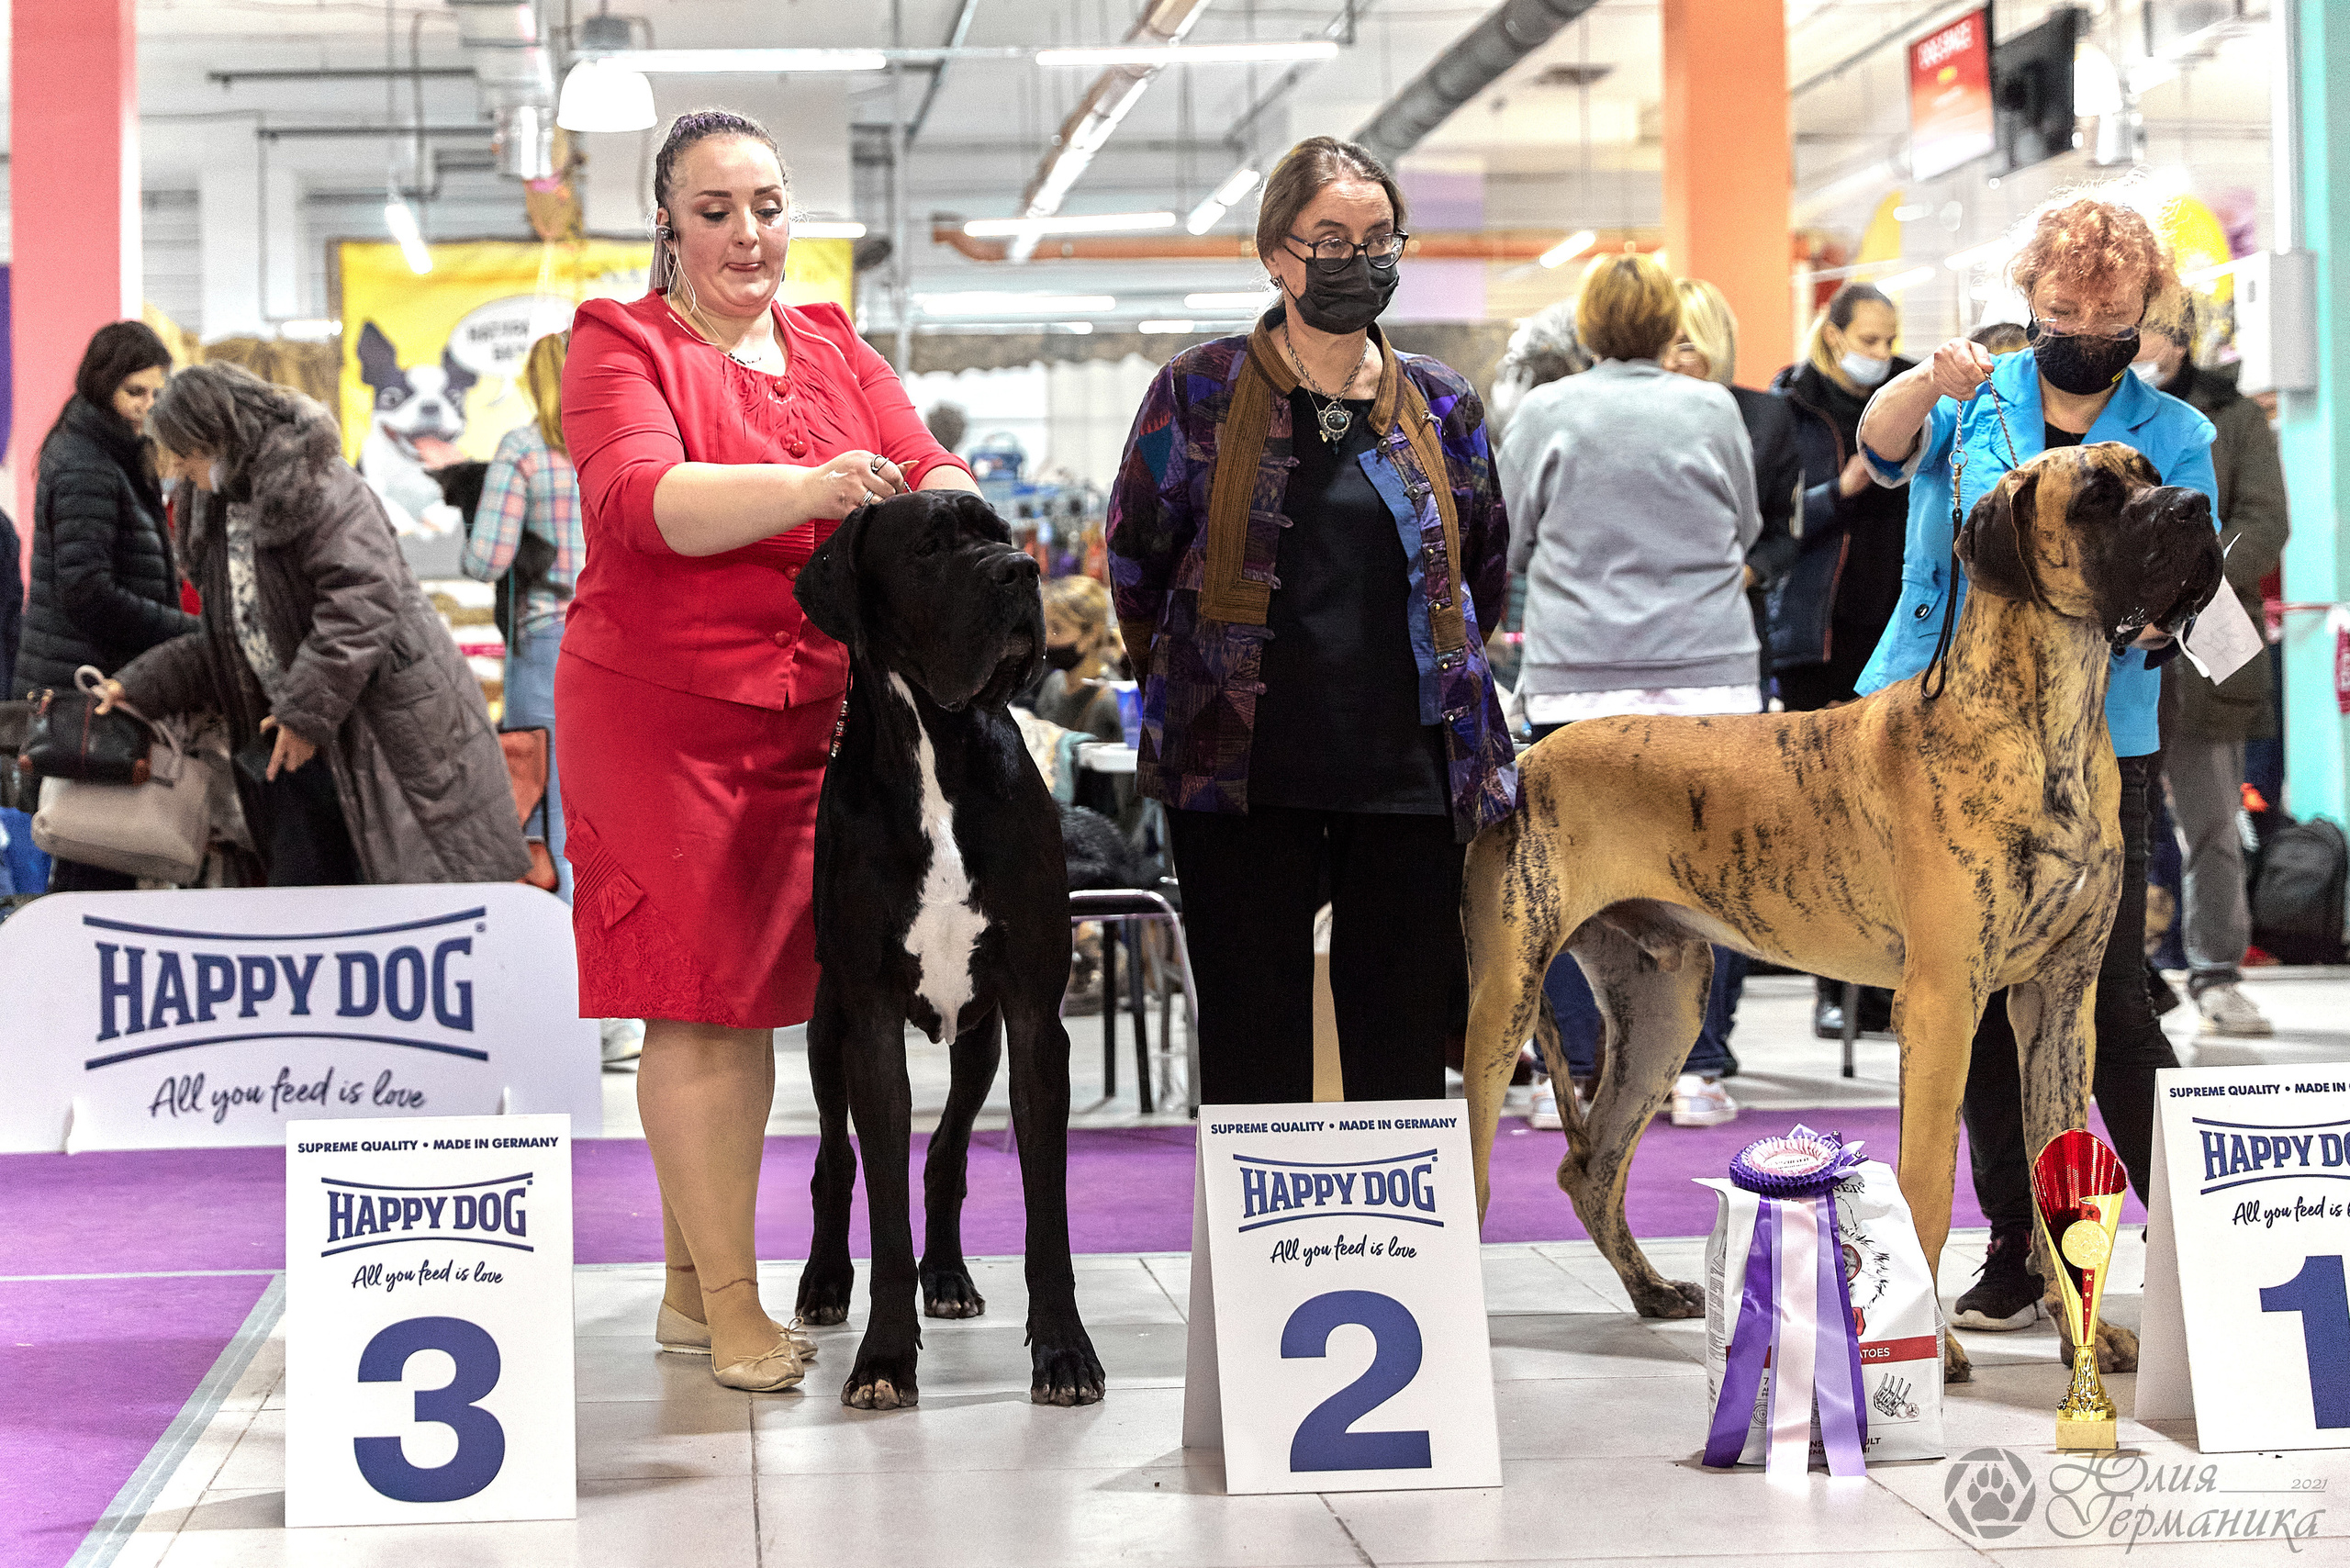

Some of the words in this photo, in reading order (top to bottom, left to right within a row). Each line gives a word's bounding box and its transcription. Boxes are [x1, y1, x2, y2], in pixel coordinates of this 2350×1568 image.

[95, 941, 323, 1041] HAPPY
[150, 1073, 205, 1116] All
[212, 1086, 263, 1124] you
[272, 1067, 333, 1112] feed
[340, 1082, 363, 1104] is
[373, 1070, 425, 1108] love
[2170, 1086, 2225, 1097] SUPREME
[2228, 1084, 2280, 1095] QUALITY
[2295, 1083, 2330, 1092] MADE
[2333, 1082, 2345, 1092] IN
[298, 1142, 357, 1153] SUPREME
[362, 1140, 418, 1151] QUALITY
[433, 1139, 470, 1149] MADE
[475, 1139, 488, 1148] IN
[493, 1137, 558, 1148] GERMANY
[1211, 1123, 1268, 1134] SUPREME
[1271, 1122, 1324, 1132] QUALITY
[1339, 1120, 1374, 1130] MADE
[1378, 1120, 1391, 1129] IN
[1395, 1118, 1457, 1129] GERMANY
[2199, 1130, 2313, 1181] HAPPY
[2319, 1131, 2350, 1168] D
[328, 1191, 448, 1243] HAPPY
[1240, 1167, 1357, 1218] HAPPY
[2232, 1200, 2260, 1225] All
[2265, 1207, 2291, 1228] you
[2295, 1196, 2325, 1222] feed
[2330, 1204, 2342, 1216] is
[352, 1263, 382, 1288] All
[386, 1271, 415, 1292] you
[419, 1260, 453, 1285] feed
[455, 1269, 469, 1281] is
[474, 1261, 502, 1283] love
[1270, 1238, 1299, 1263] All
[1304, 1246, 1331, 1267] you
[1335, 1235, 1367, 1260] feed
[1371, 1243, 1382, 1256] is
[1389, 1237, 1416, 1258] love
[1860, 1348, 1890, 1358] TOES
[2259, 1255, 2350, 1429] 1
[1281, 1290, 1432, 1473] 2
[353, 1316, 505, 1503] 3
